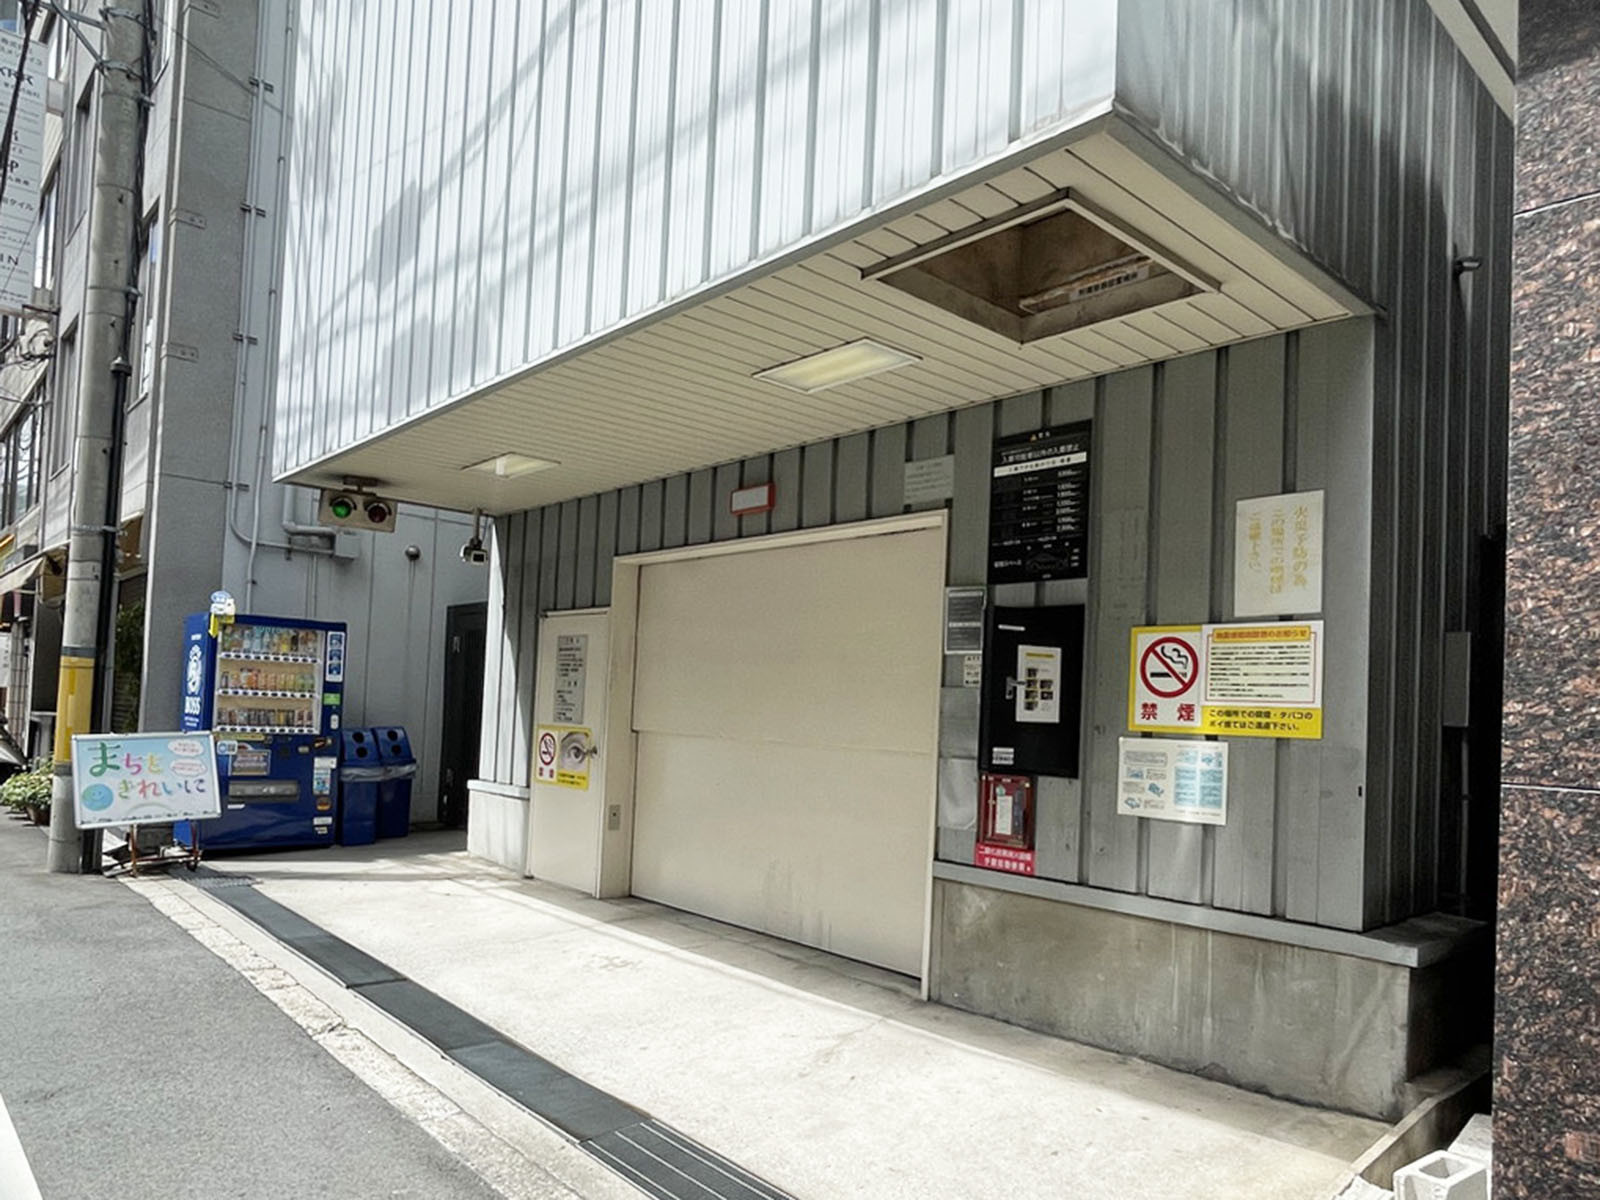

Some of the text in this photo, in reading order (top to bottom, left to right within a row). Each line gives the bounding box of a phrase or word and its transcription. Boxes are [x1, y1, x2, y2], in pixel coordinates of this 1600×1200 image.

[1141, 702, 1195, 721] 禁煙
[118, 778, 206, 799] きれいに
